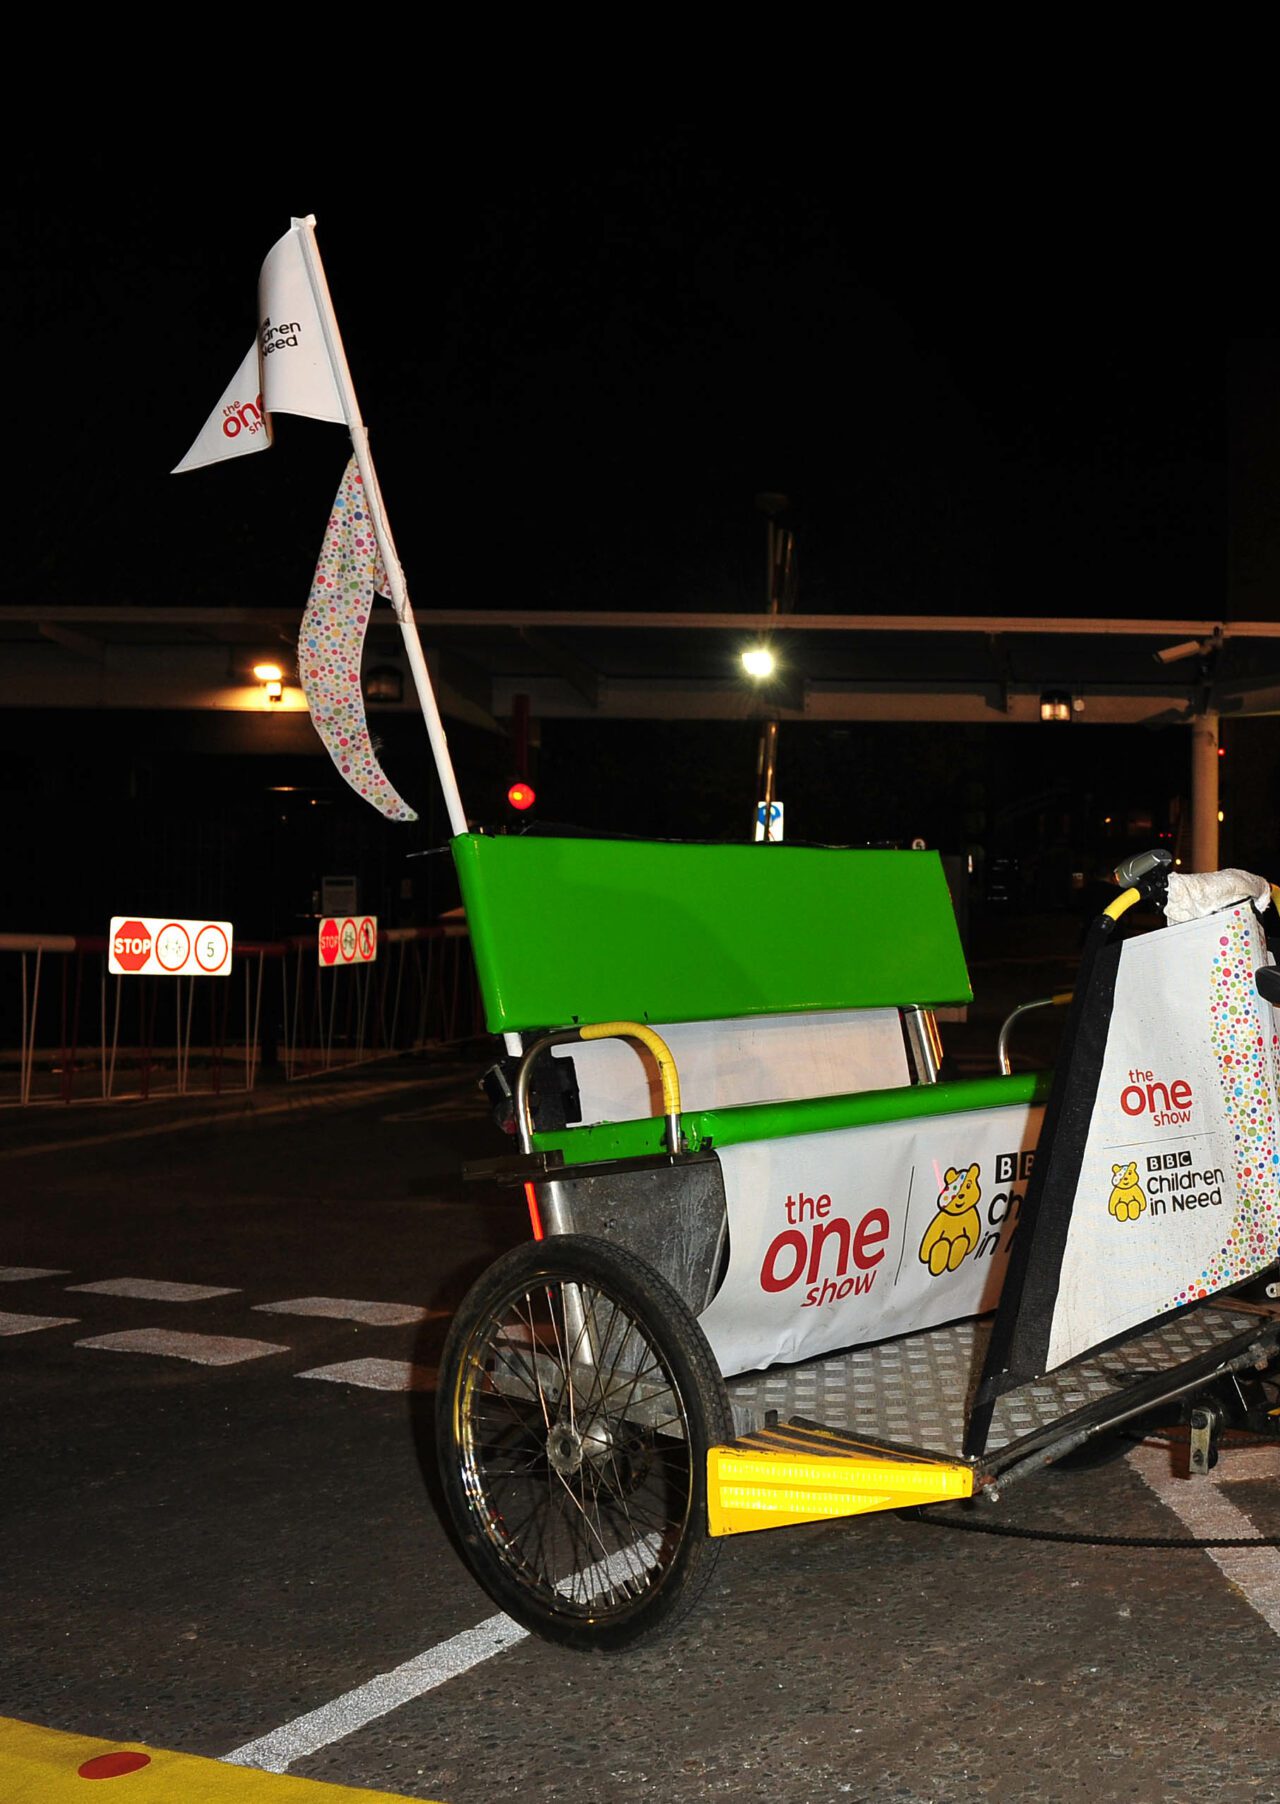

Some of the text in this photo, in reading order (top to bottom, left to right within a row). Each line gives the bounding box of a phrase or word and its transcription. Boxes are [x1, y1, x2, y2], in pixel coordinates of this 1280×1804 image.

[223, 400, 240, 416] the
[114, 937, 152, 955] STOP
[206, 941, 215, 958] 5
[320, 935, 338, 949] STOP
[1129, 1069, 1154, 1084] the
[1120, 1079, 1193, 1116] one
[1153, 1110, 1191, 1127] show
[1148, 1152, 1191, 1171] BBC
[1147, 1168, 1225, 1194] Children
[785, 1192, 831, 1225] the
[1150, 1187, 1223, 1216] in Need
[759, 1207, 890, 1294] one
[973, 1230, 1001, 1260] in
[800, 1269, 877, 1308] show
